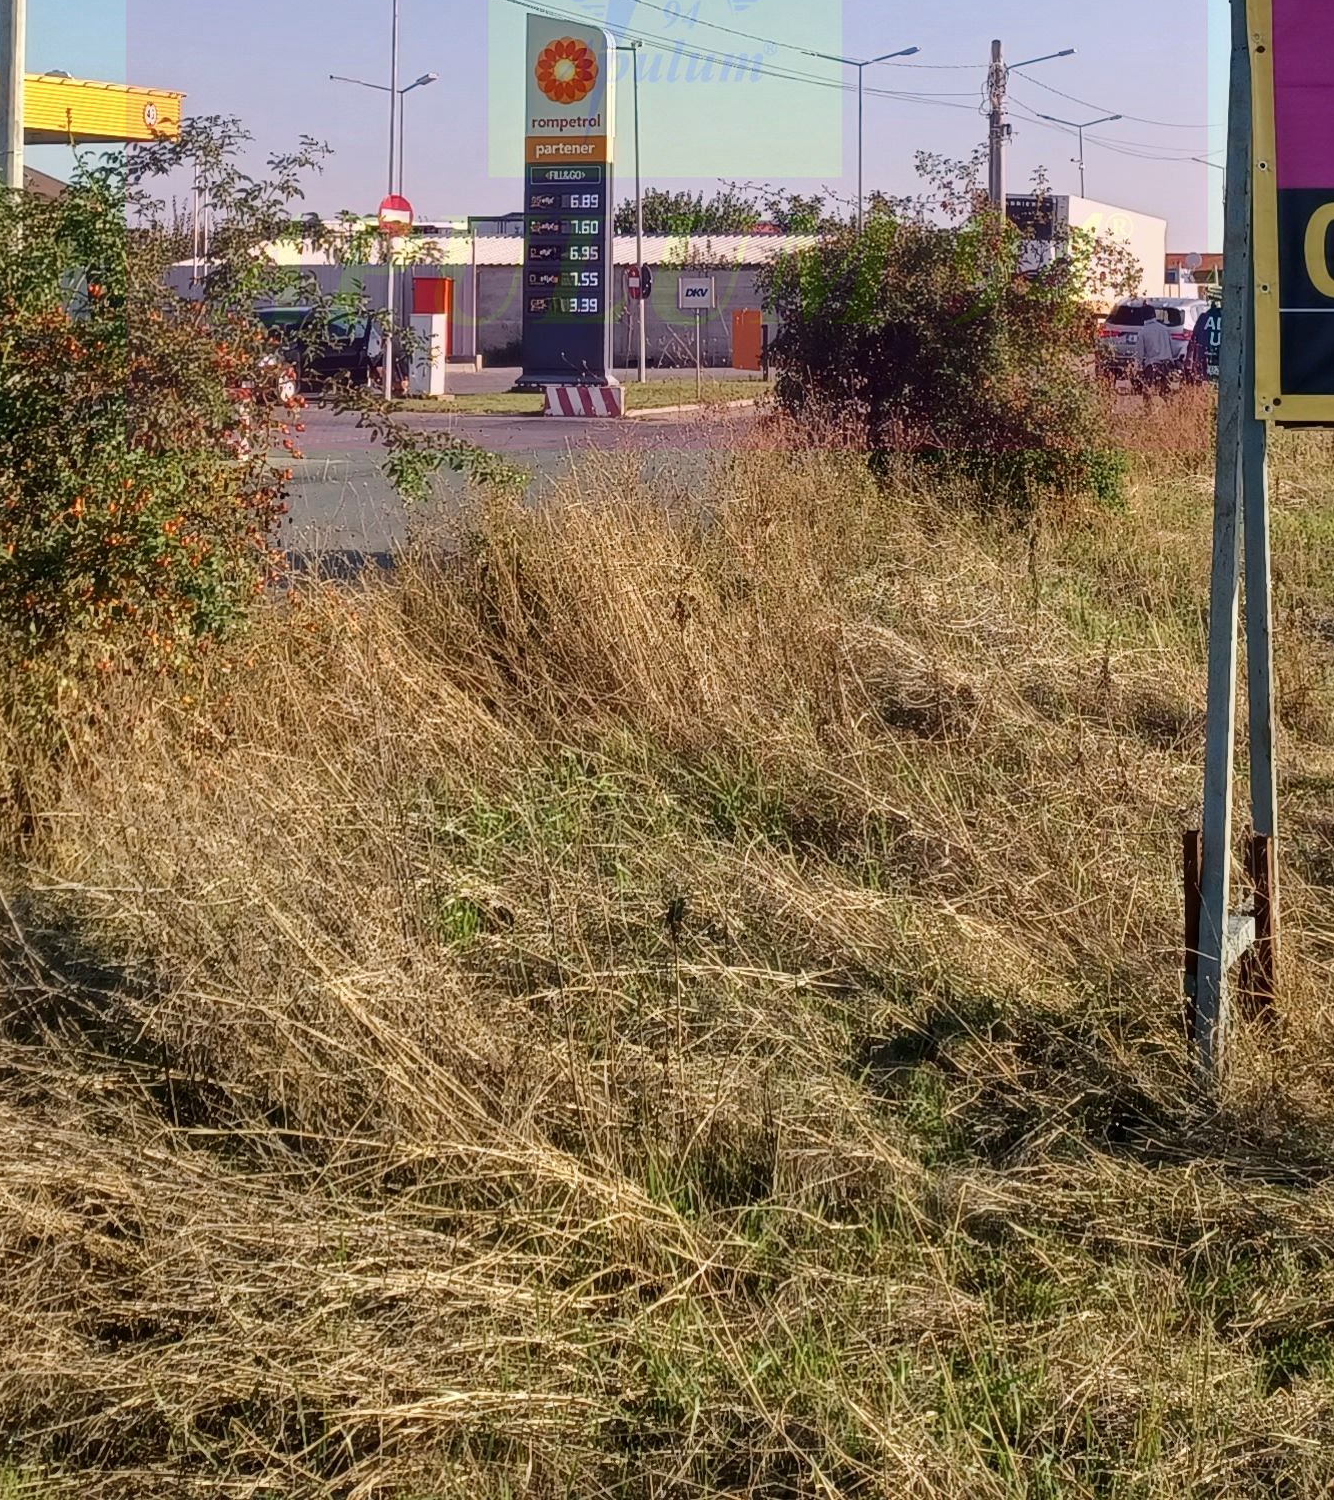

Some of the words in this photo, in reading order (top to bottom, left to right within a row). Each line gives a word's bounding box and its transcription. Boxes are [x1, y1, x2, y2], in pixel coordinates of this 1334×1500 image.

[532, 113, 601, 132] rompetrol
[536, 143, 596, 159] partener
[570, 194, 599, 209] 6.89
[570, 246, 599, 260] 6.95
[570, 272, 599, 287] 7.55
[685, 288, 708, 297] DKV
[569, 298, 598, 312] 3.39
